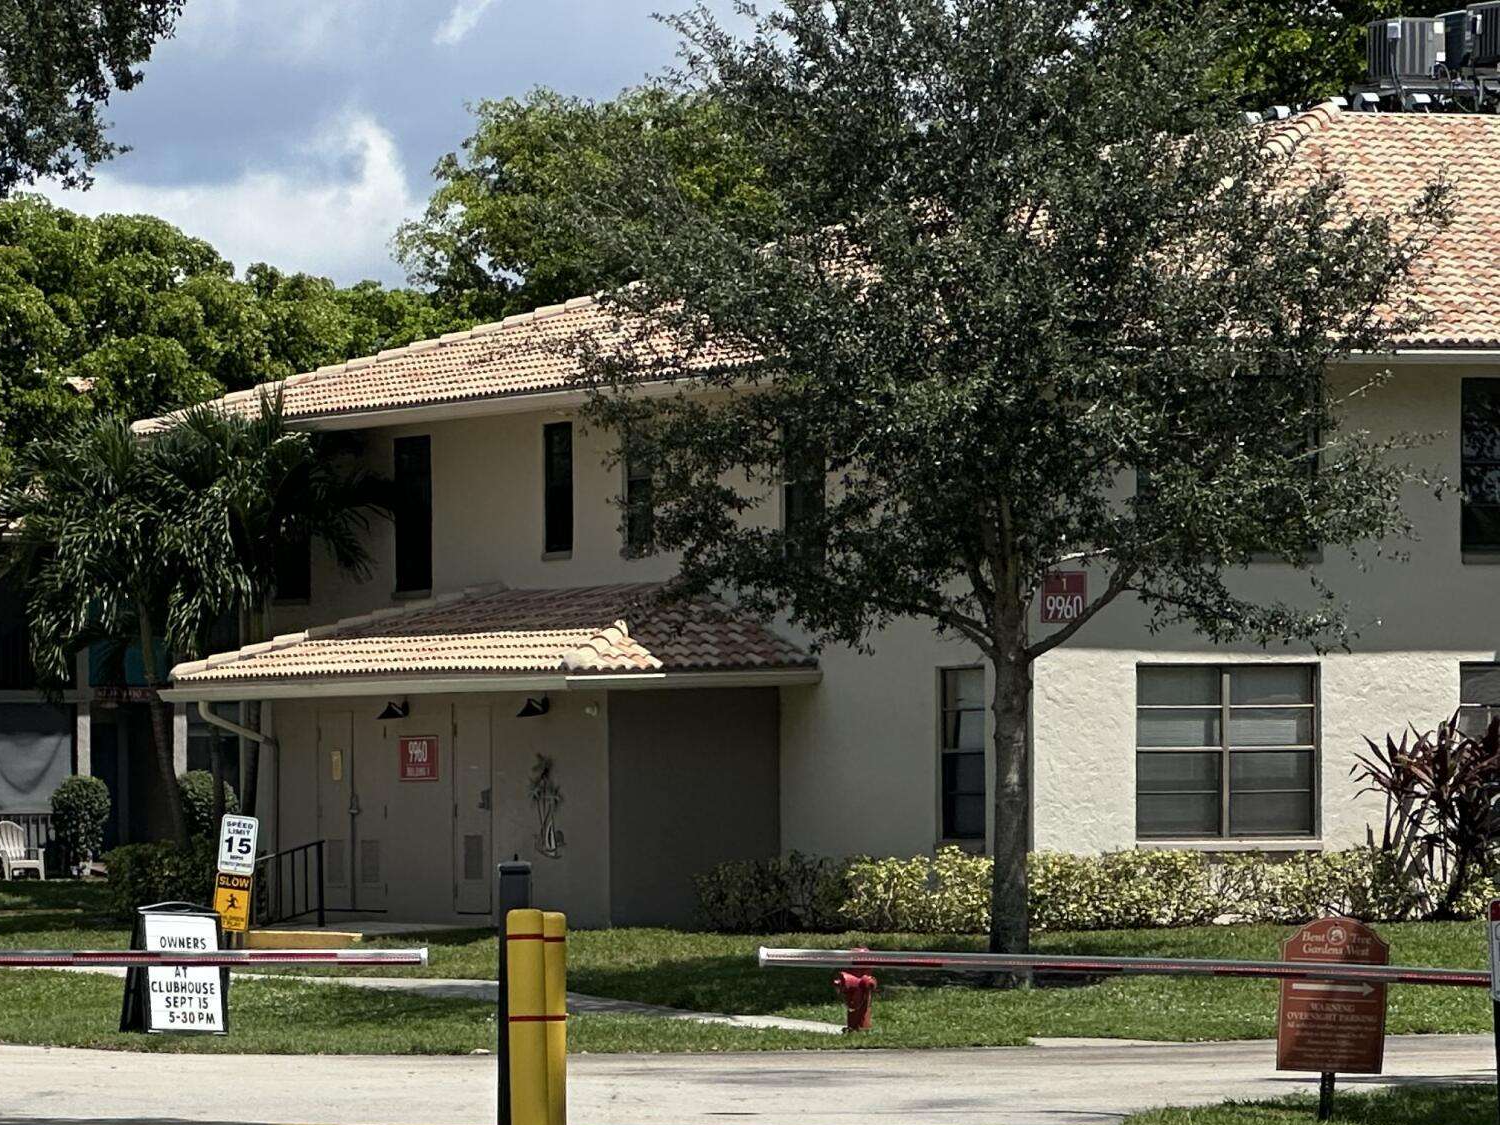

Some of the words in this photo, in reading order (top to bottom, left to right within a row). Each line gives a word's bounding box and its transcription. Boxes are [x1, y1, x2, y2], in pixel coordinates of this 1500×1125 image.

[1046, 595, 1083, 619] 9960
[408, 740, 428, 762] 9960
[227, 820, 253, 830] SPEED
[228, 828, 250, 836] LIMIT
[224, 836, 251, 855] 15
[220, 876, 250, 888] SLOW
[160, 936, 207, 950] OWNERS
[1302, 930, 1326, 942] Bent
[1351, 933, 1373, 944] Tree
[1302, 942, 1343, 955] Gardens
[1346, 944, 1370, 957] West
[175, 966, 188, 978] AT
[151, 981, 216, 995] CLUBHOUSE
[165, 996, 193, 1009] SEPT
[198, 997, 209, 1010] 15
[1310, 1002, 1356, 1012] WARNING
[169, 1011, 195, 1024] 5-30
[198, 1012, 215, 1024] PM
[1286, 1011, 1337, 1023] OVERNIGHT
